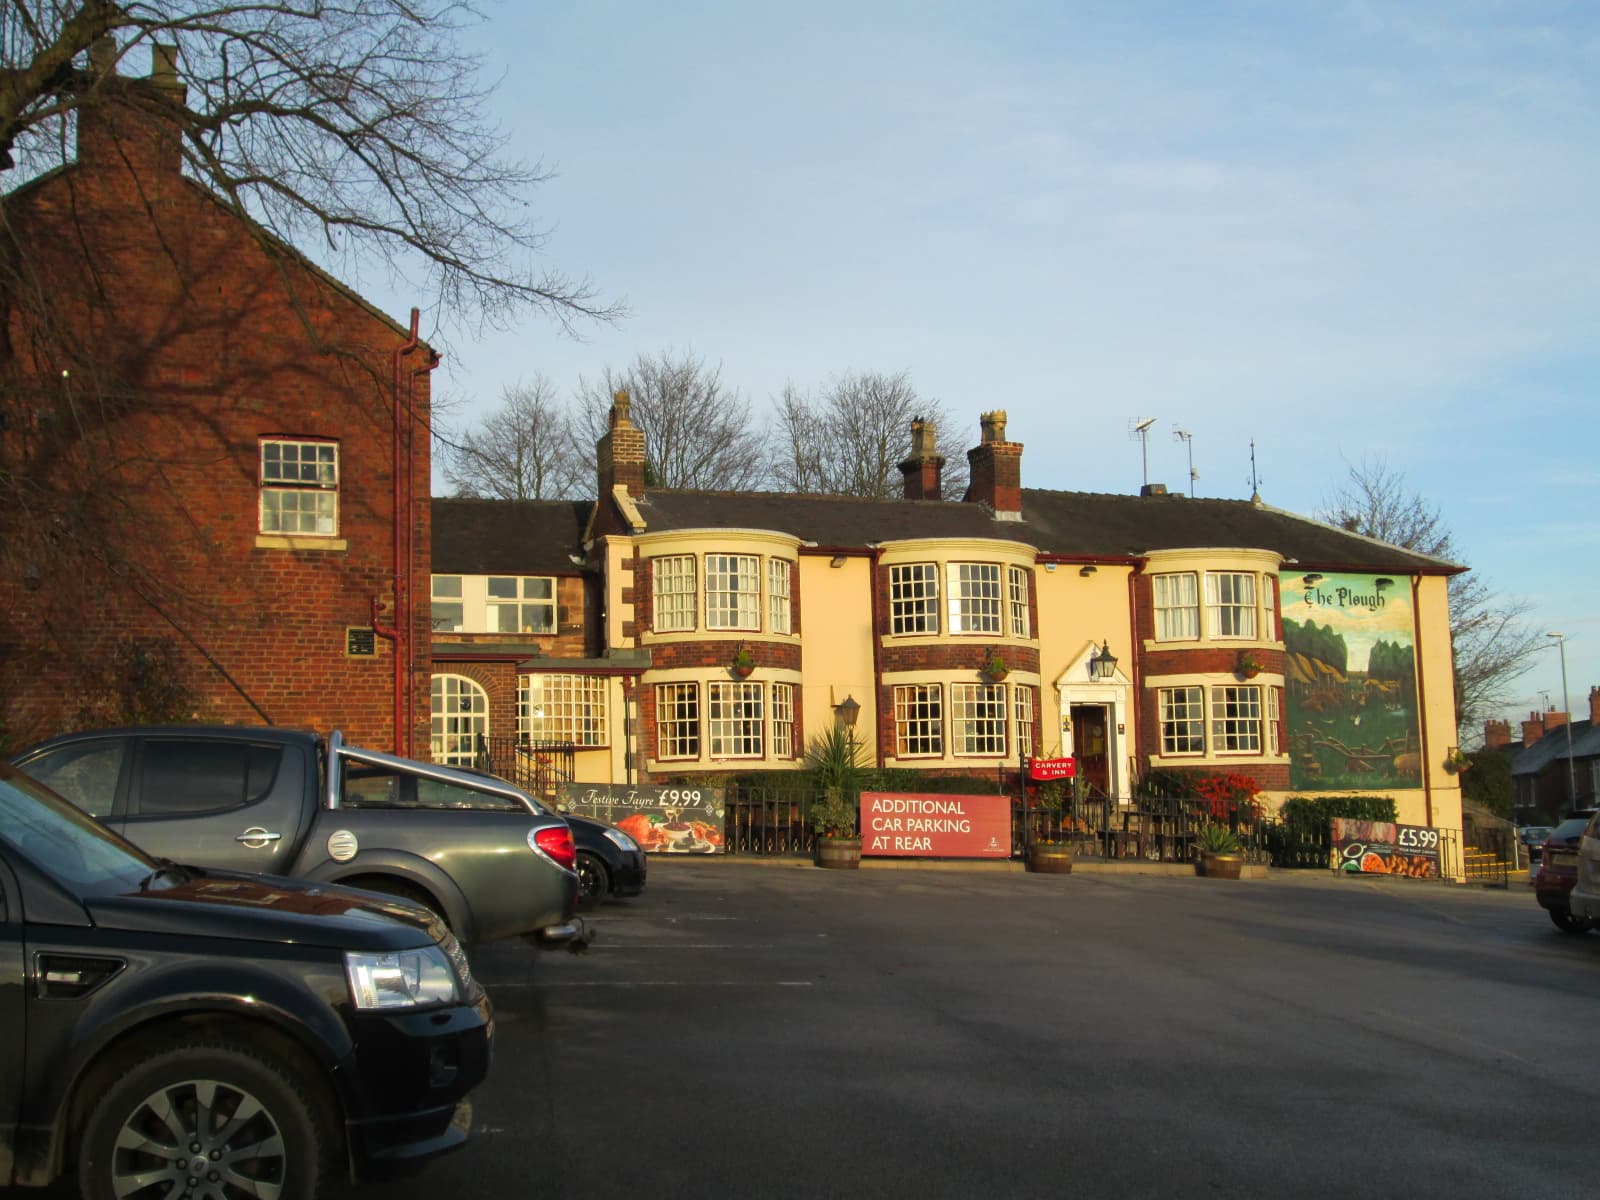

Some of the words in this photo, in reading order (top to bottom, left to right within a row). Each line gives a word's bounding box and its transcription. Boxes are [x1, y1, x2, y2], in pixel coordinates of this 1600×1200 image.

[1303, 586, 1333, 608] The
[1336, 587, 1385, 611] Plough
[581, 789, 619, 805] Festive
[621, 790, 654, 809] Fayre
[659, 789, 701, 807] £9.99
[871, 799, 965, 815] ADDITIONAL
[872, 817, 903, 832] CAR
[907, 818, 971, 833] PARKING
[871, 836, 891, 850] AT
[895, 837, 932, 851] REAR
[1398, 828, 1438, 849] £5.99
